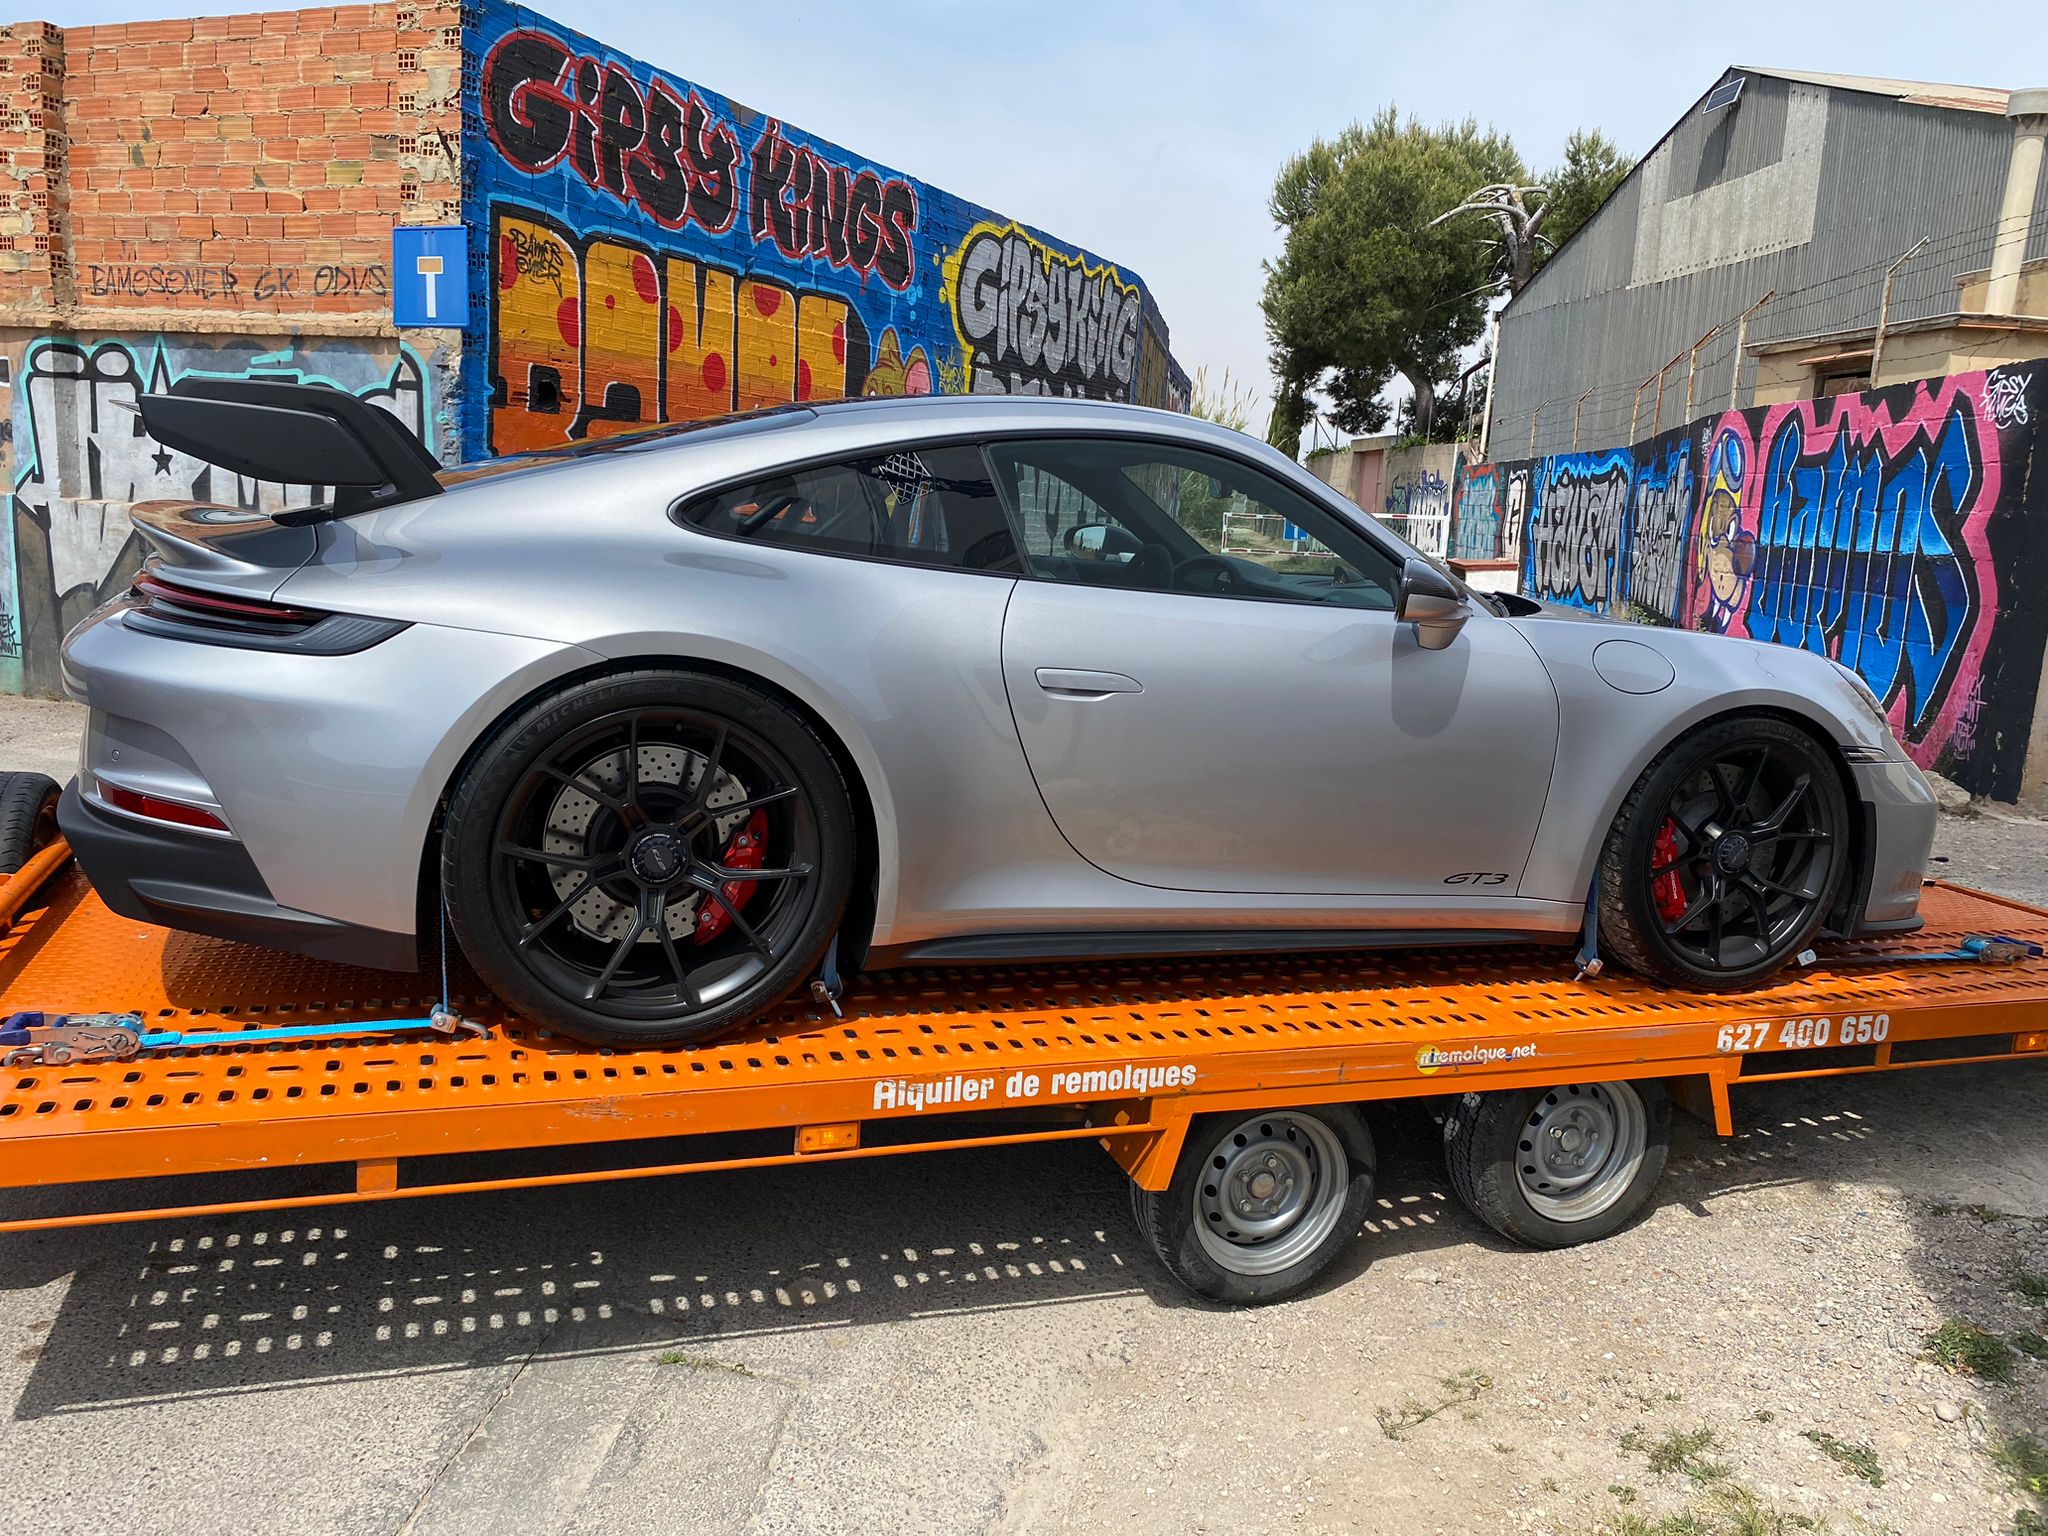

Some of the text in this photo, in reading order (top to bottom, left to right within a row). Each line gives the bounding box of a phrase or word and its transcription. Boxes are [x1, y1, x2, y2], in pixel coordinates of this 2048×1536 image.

[536, 684, 632, 733] MICHELIN
[1443, 872, 1509, 885] GT3
[1716, 1013, 1890, 1053] 627 400 650
[1005, 1071, 1040, 1098] de
[1051, 1064, 1197, 1096] remolques
